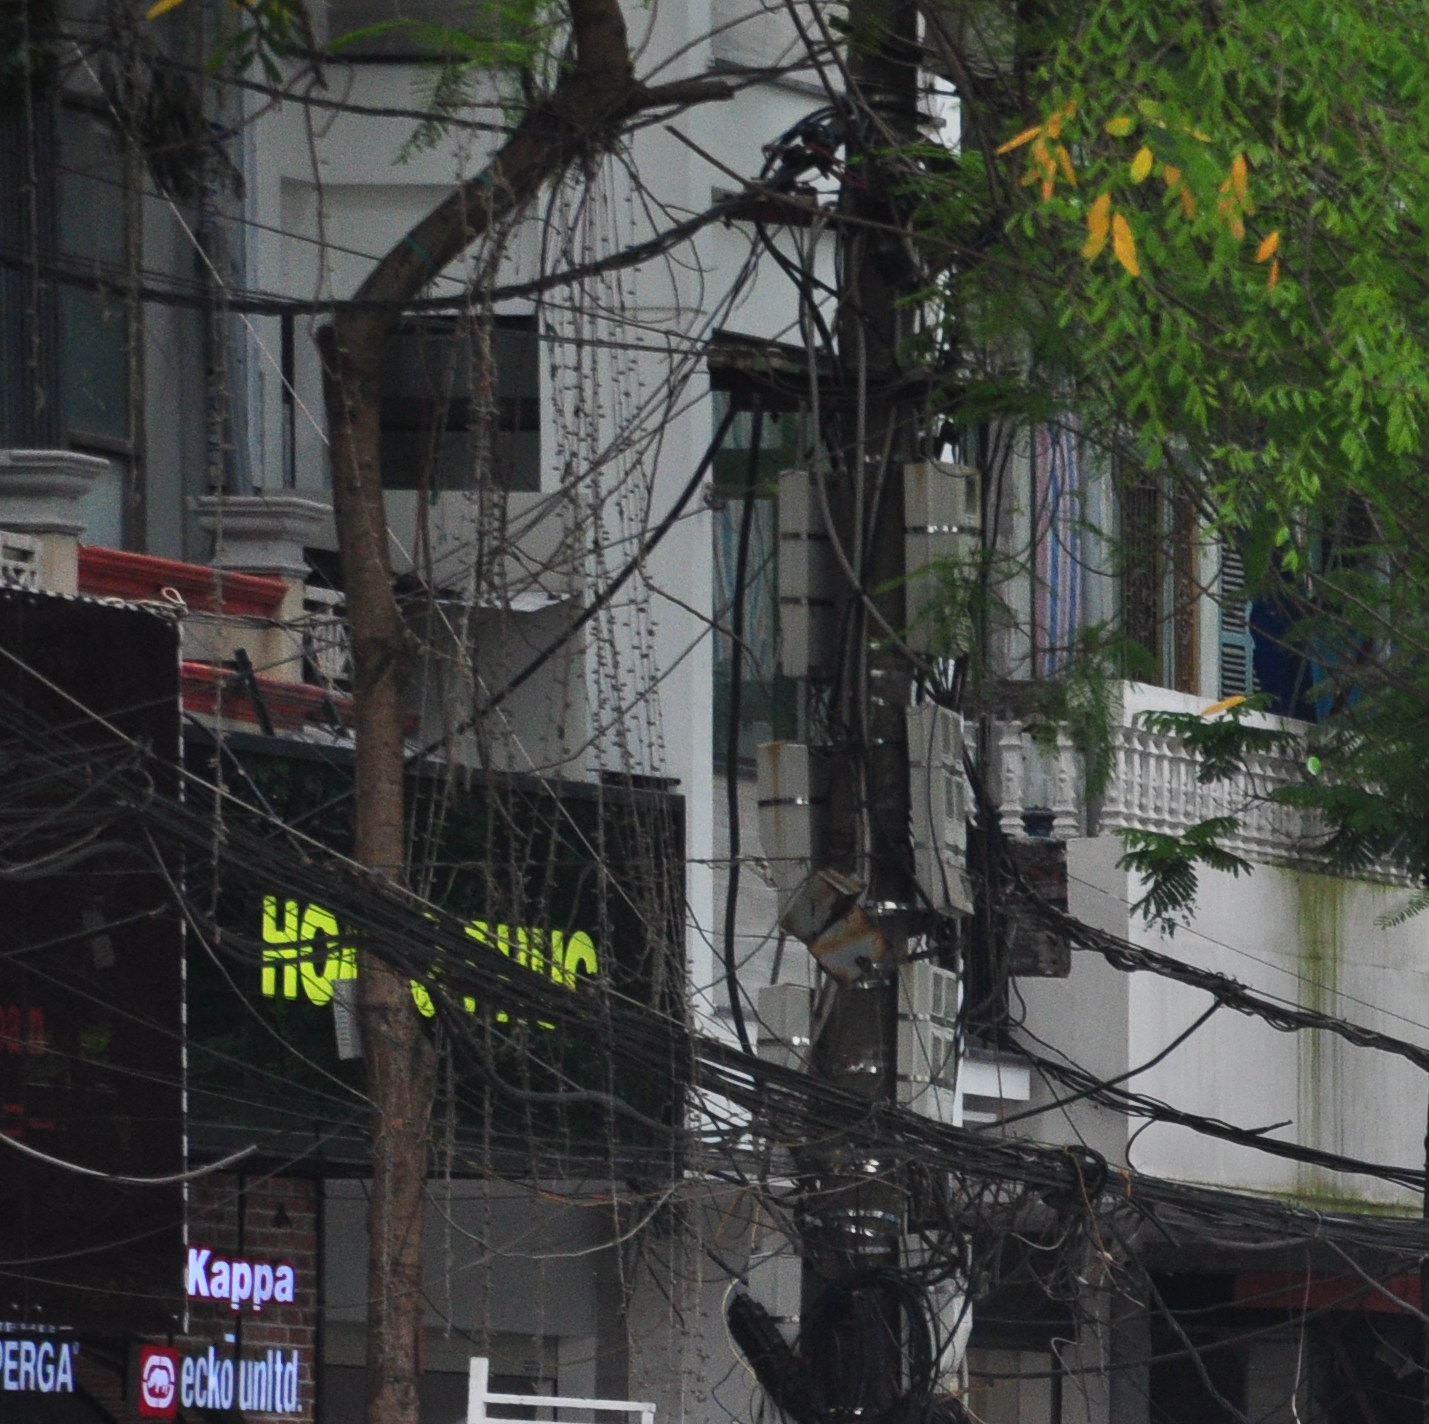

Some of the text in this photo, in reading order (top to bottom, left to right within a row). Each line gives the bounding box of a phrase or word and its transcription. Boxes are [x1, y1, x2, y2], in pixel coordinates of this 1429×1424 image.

[187, 1248, 294, 1311] Kappa
[0, 1341, 75, 1392] ERGA
[182, 1346, 234, 1409] ecko
